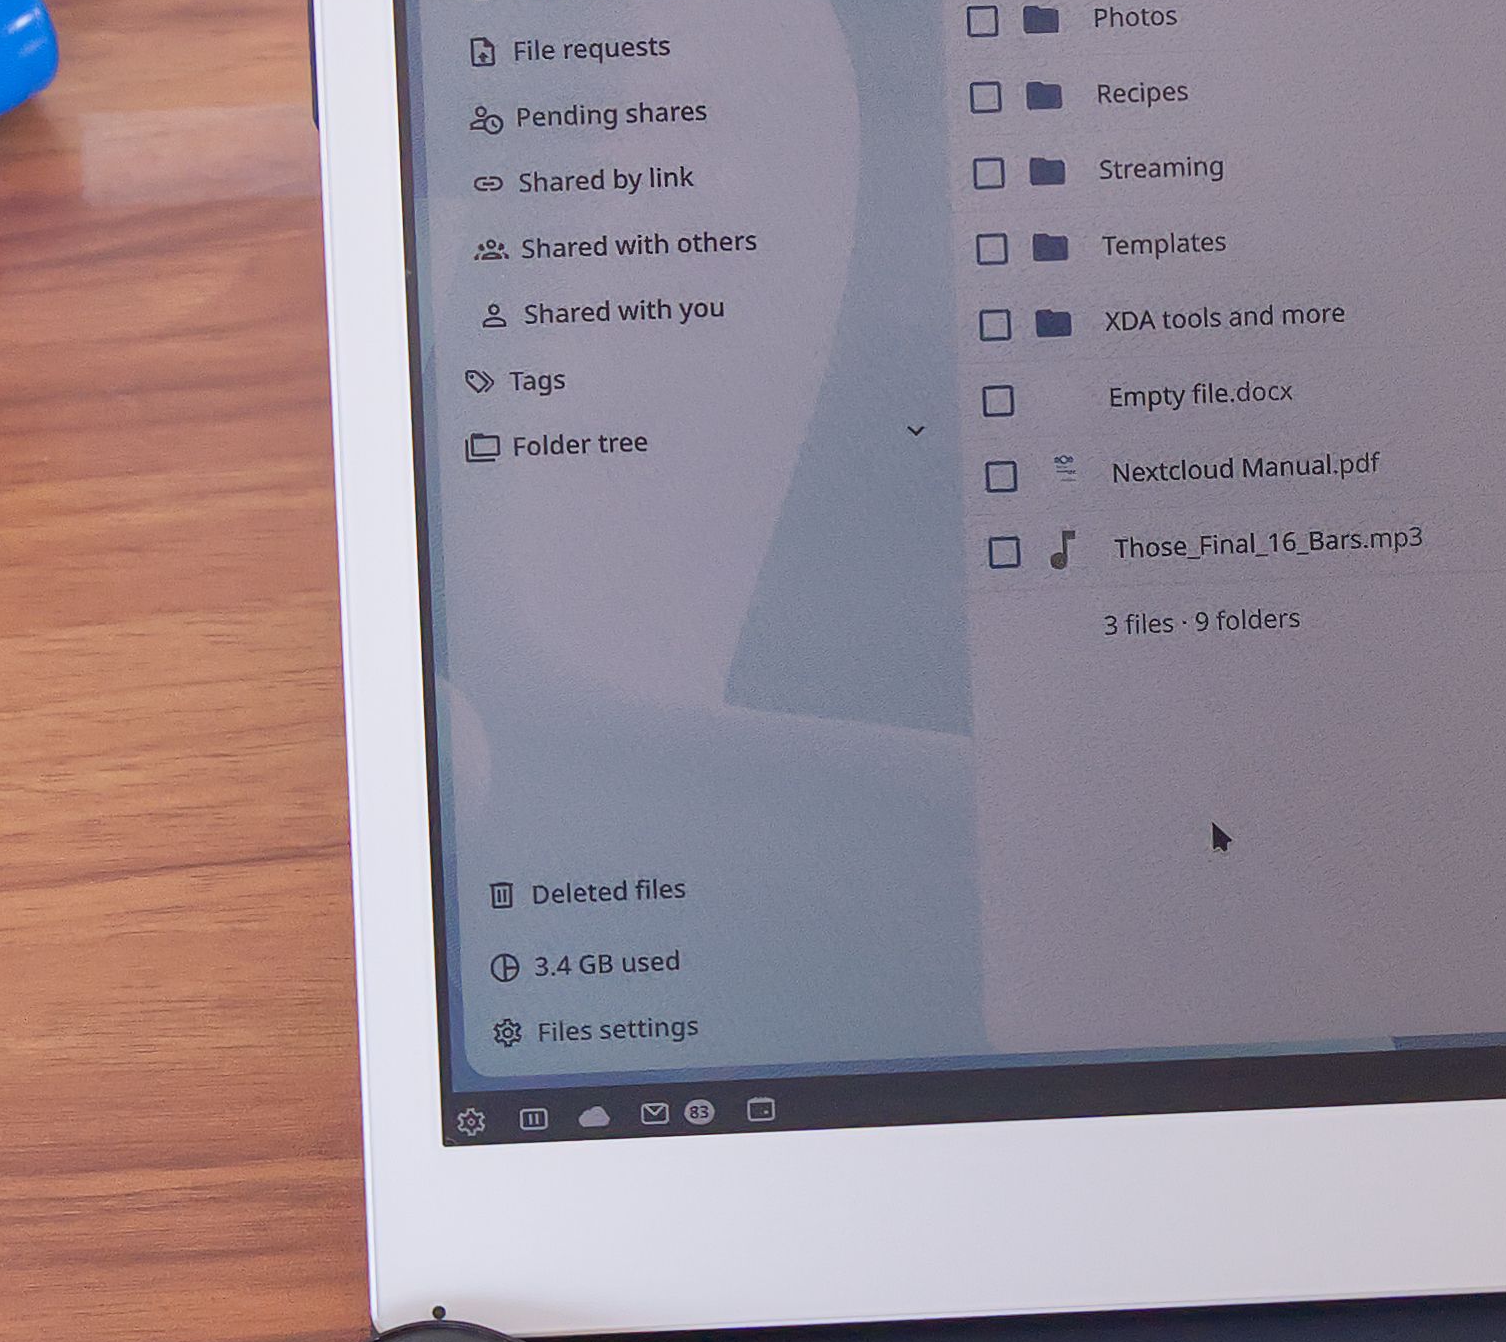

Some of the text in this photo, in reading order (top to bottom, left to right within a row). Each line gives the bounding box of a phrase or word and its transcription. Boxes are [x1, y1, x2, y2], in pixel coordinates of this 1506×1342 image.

[1094, 6, 1178, 28] Photos
[514, 37, 671, 64] File requests
[1097, 81, 1189, 109] Recipes
[517, 101, 708, 131] Pending shares
[519, 165, 694, 195] Shared by link
[1099, 156, 1224, 182] Streaming
[521, 231, 757, 260] Shared with others
[1101, 232, 1227, 260] Templates
[524, 298, 725, 325] Shared with you
[1105, 304, 1345, 332] XDA tools and more
[508, 371, 566, 397] Tags
[1109, 380, 1293, 412] Empty file.docx
[513, 433, 648, 457] Folder tree
[1113, 457, 1234, 484] Nextcloud
[1242, 451, 1381, 480] Manual.pdf
[1113, 526, 1423, 560] Those_Final_16_Bars.mp3
[1104, 608, 1301, 636] 3 files 9 folders
[532, 878, 686, 905] Deleted files
[535, 949, 680, 977] 3.4 GB used
[538, 1017, 699, 1043] Files settings
[689, 1105, 709, 1119] 83
